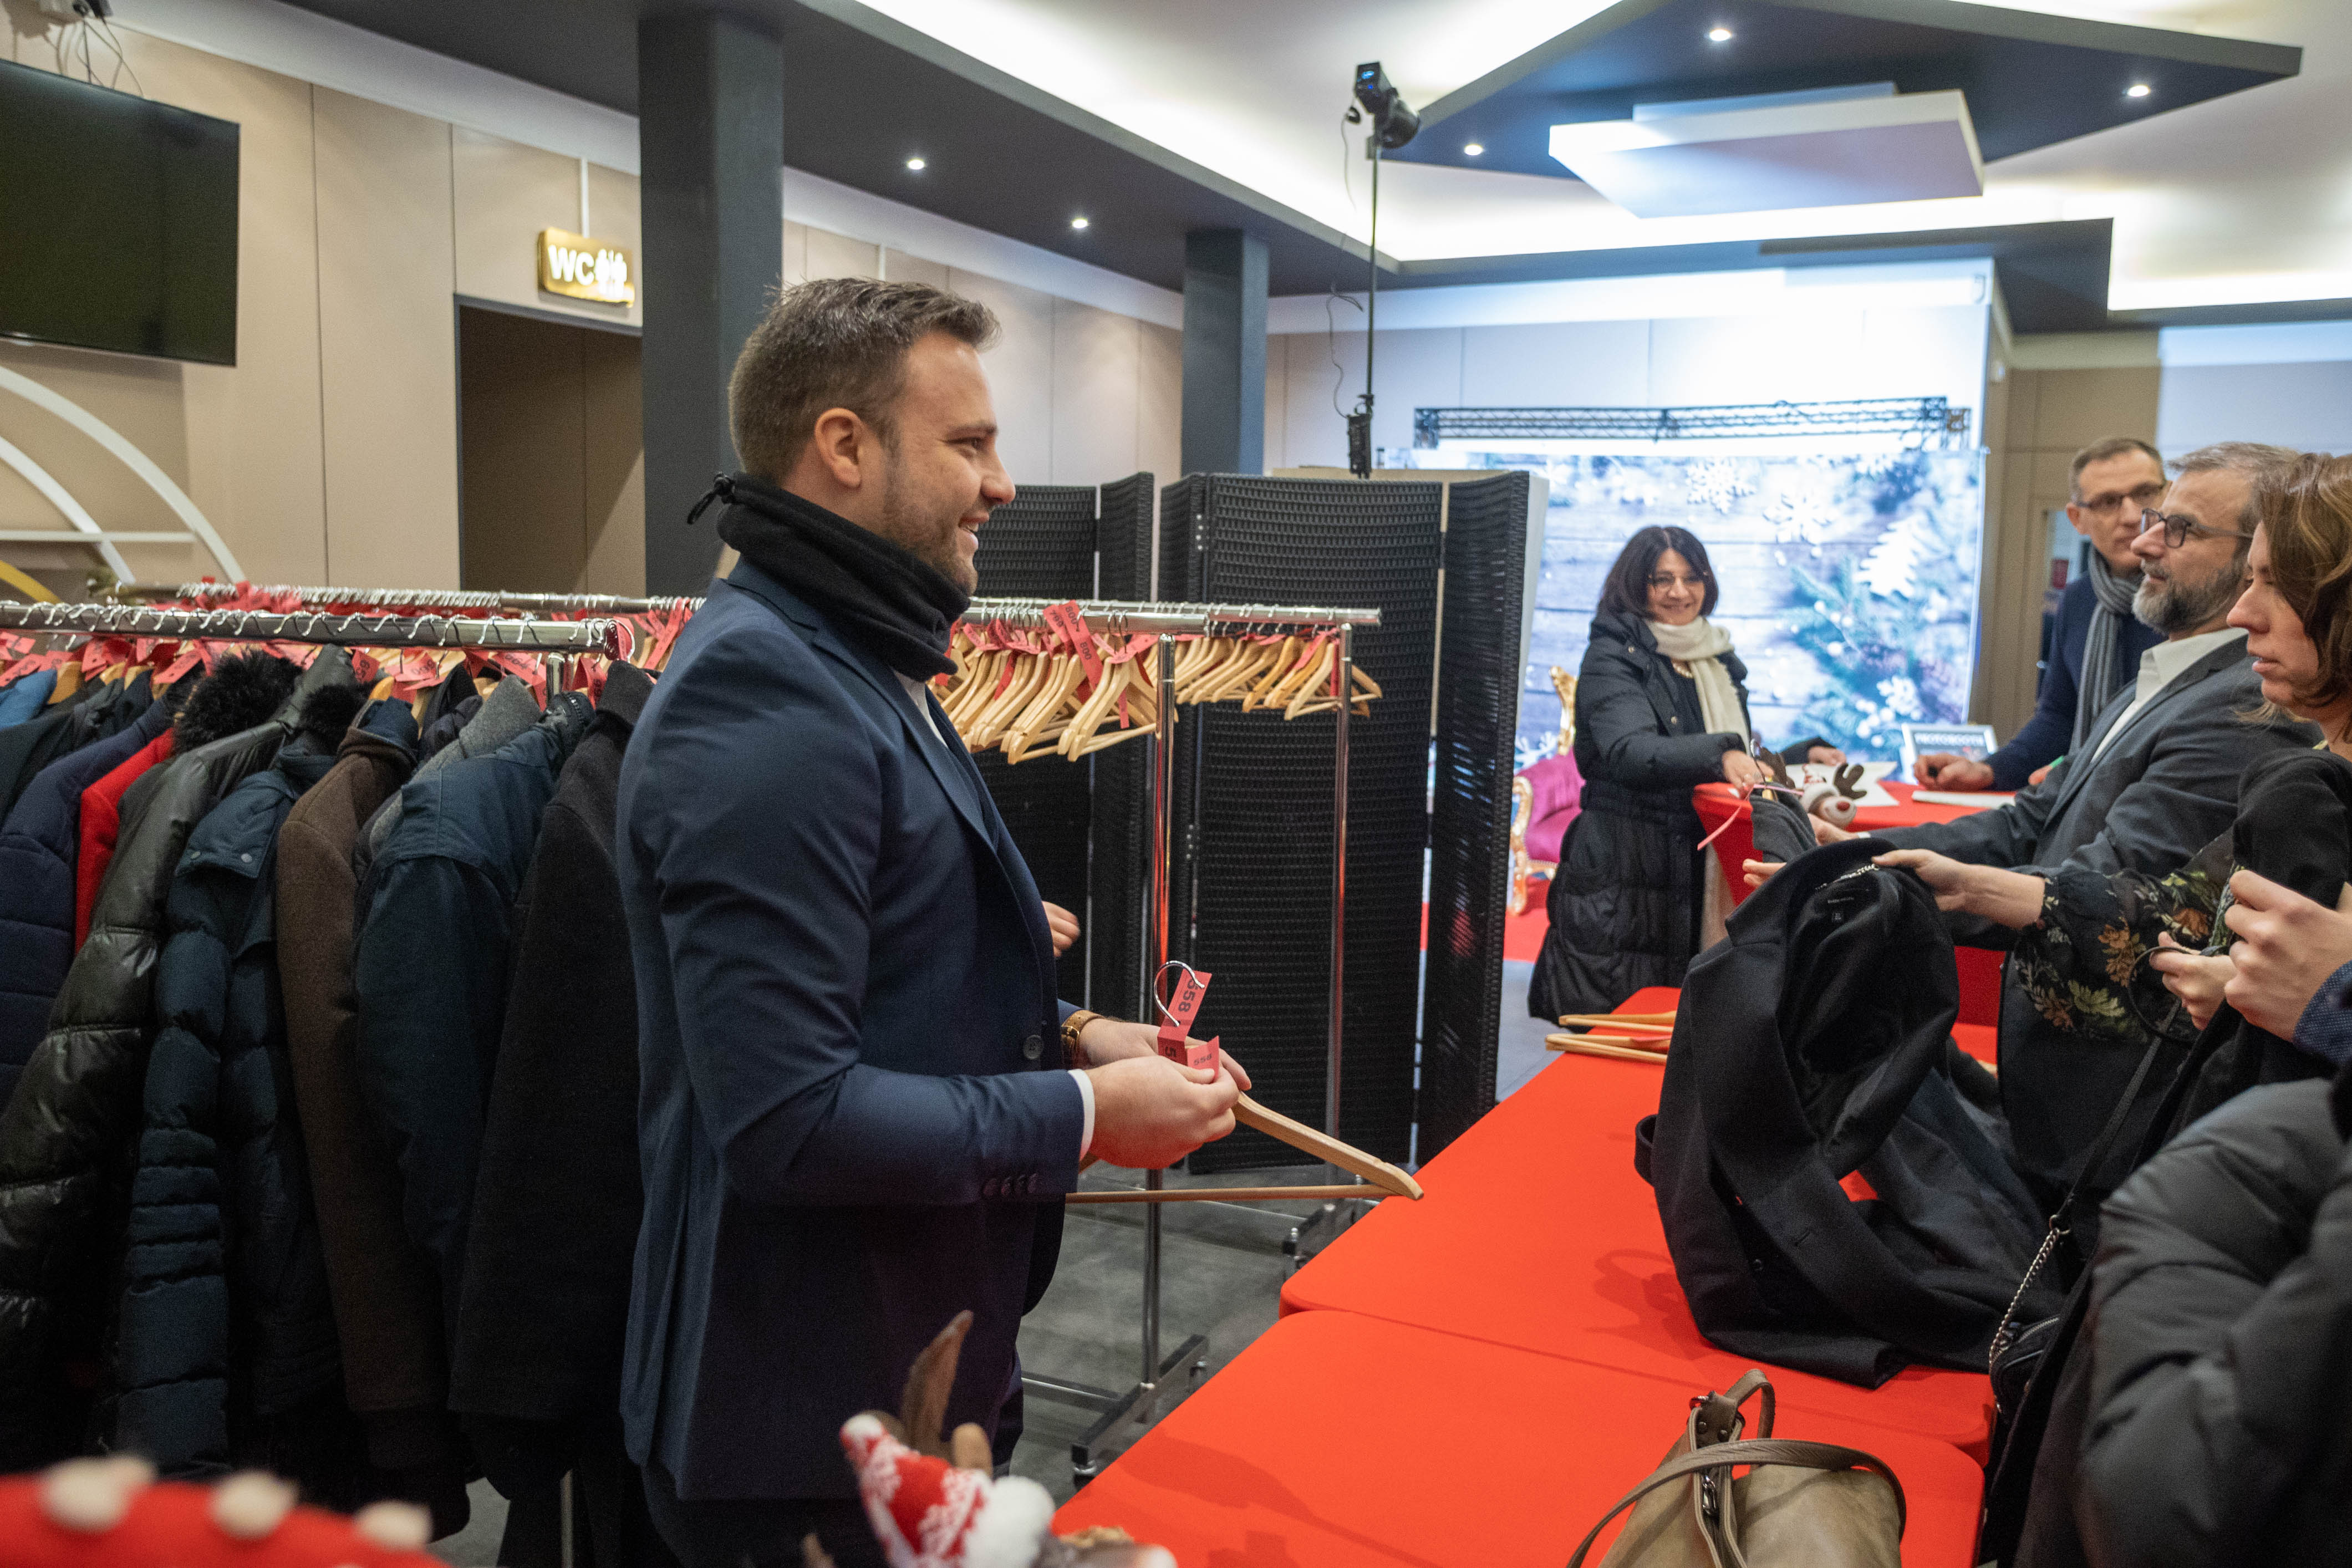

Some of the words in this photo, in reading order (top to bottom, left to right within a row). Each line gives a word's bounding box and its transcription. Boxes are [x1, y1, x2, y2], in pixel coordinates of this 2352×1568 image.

[547, 245, 595, 286] WC
[1065, 605, 1078, 625] 800
[1080, 641, 1092, 660] 800
[1194, 1053, 1213, 1066] 558
